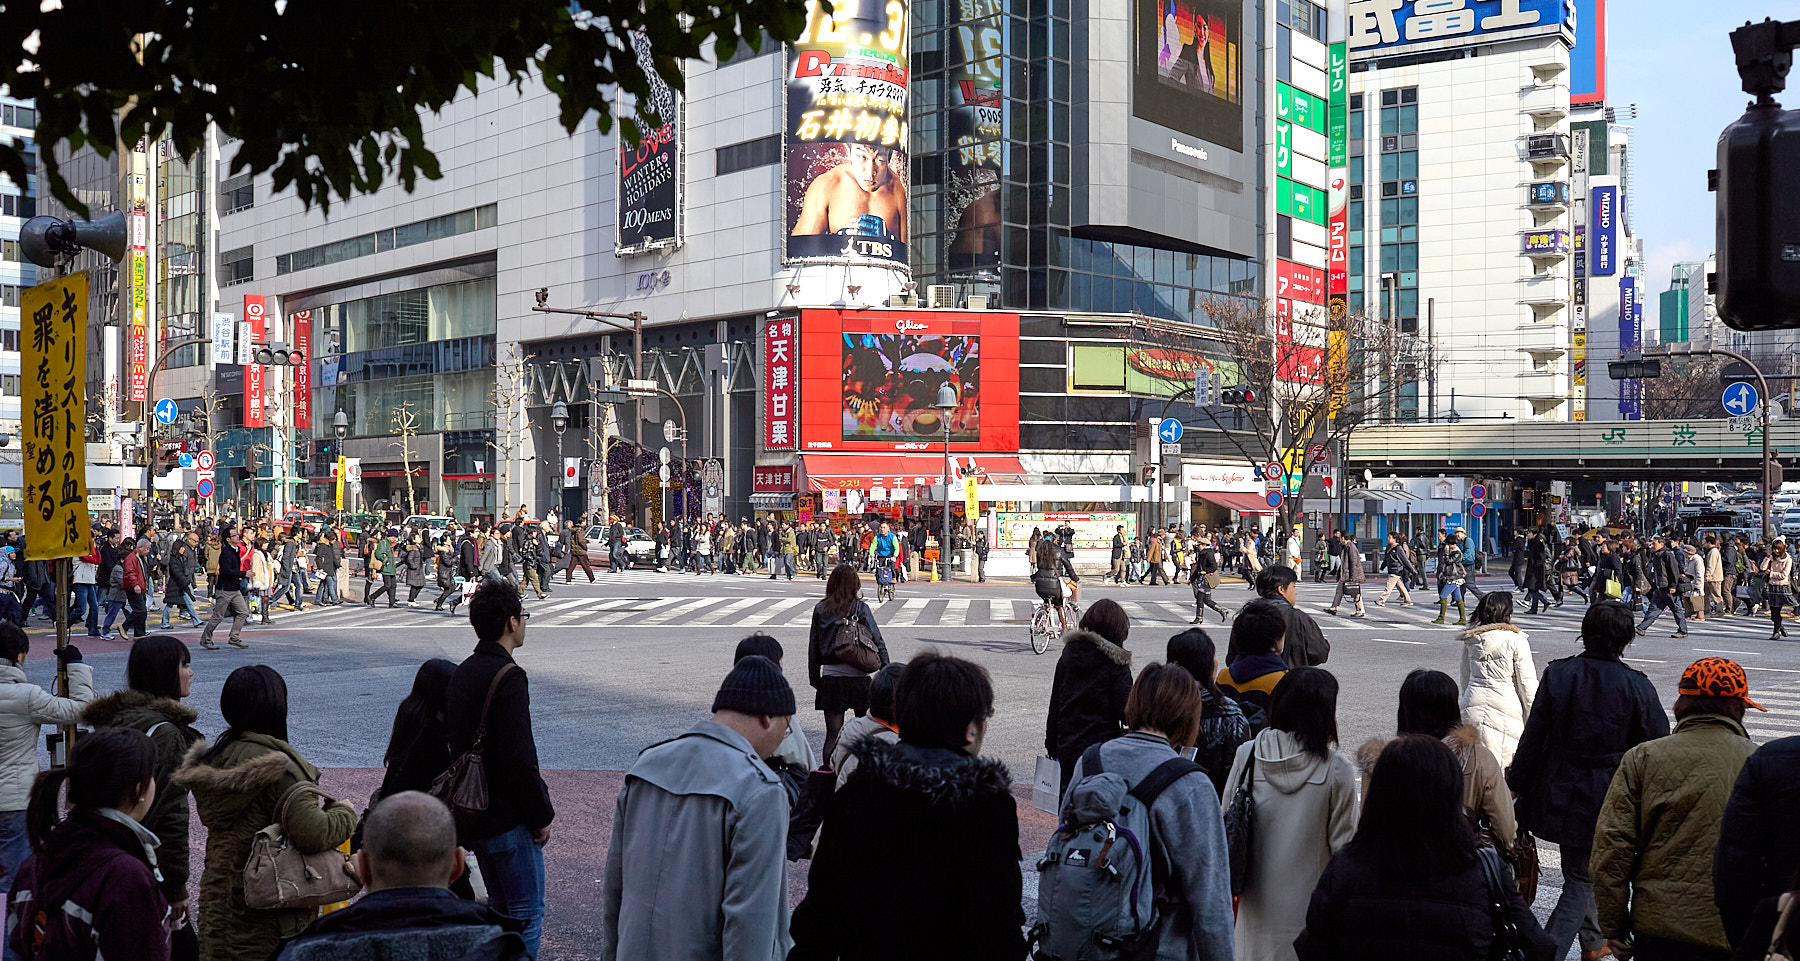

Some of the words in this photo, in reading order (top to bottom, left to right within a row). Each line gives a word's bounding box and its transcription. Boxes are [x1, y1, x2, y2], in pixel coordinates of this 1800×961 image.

[1331, 54, 1344, 92] レイク
[1277, 93, 1289, 168] レイク
[624, 156, 662, 189] WINTER
[626, 167, 672, 207] HOLIDAYS
[1602, 192, 1610, 228] MIZUHO
[856, 240, 893, 258] TBS
[1331, 222, 1345, 262] アコム
[1624, 287, 1633, 321] MIZUHO
[220, 317, 231, 360] 渋谷駅前
[768, 324, 792, 338] 名物
[895, 319, 929, 334] Glico
[250, 332, 261, 419] 三京UFJ銀行
[772, 339, 788, 445] 天津甘栗
[32, 302, 58, 522] 罪を清める
[60, 287, 82, 547] キリストの血は
[1602, 428, 1626, 441] JR
[25, 441, 36, 504] 聖書
[756, 472, 792, 485] 天津甘栗
